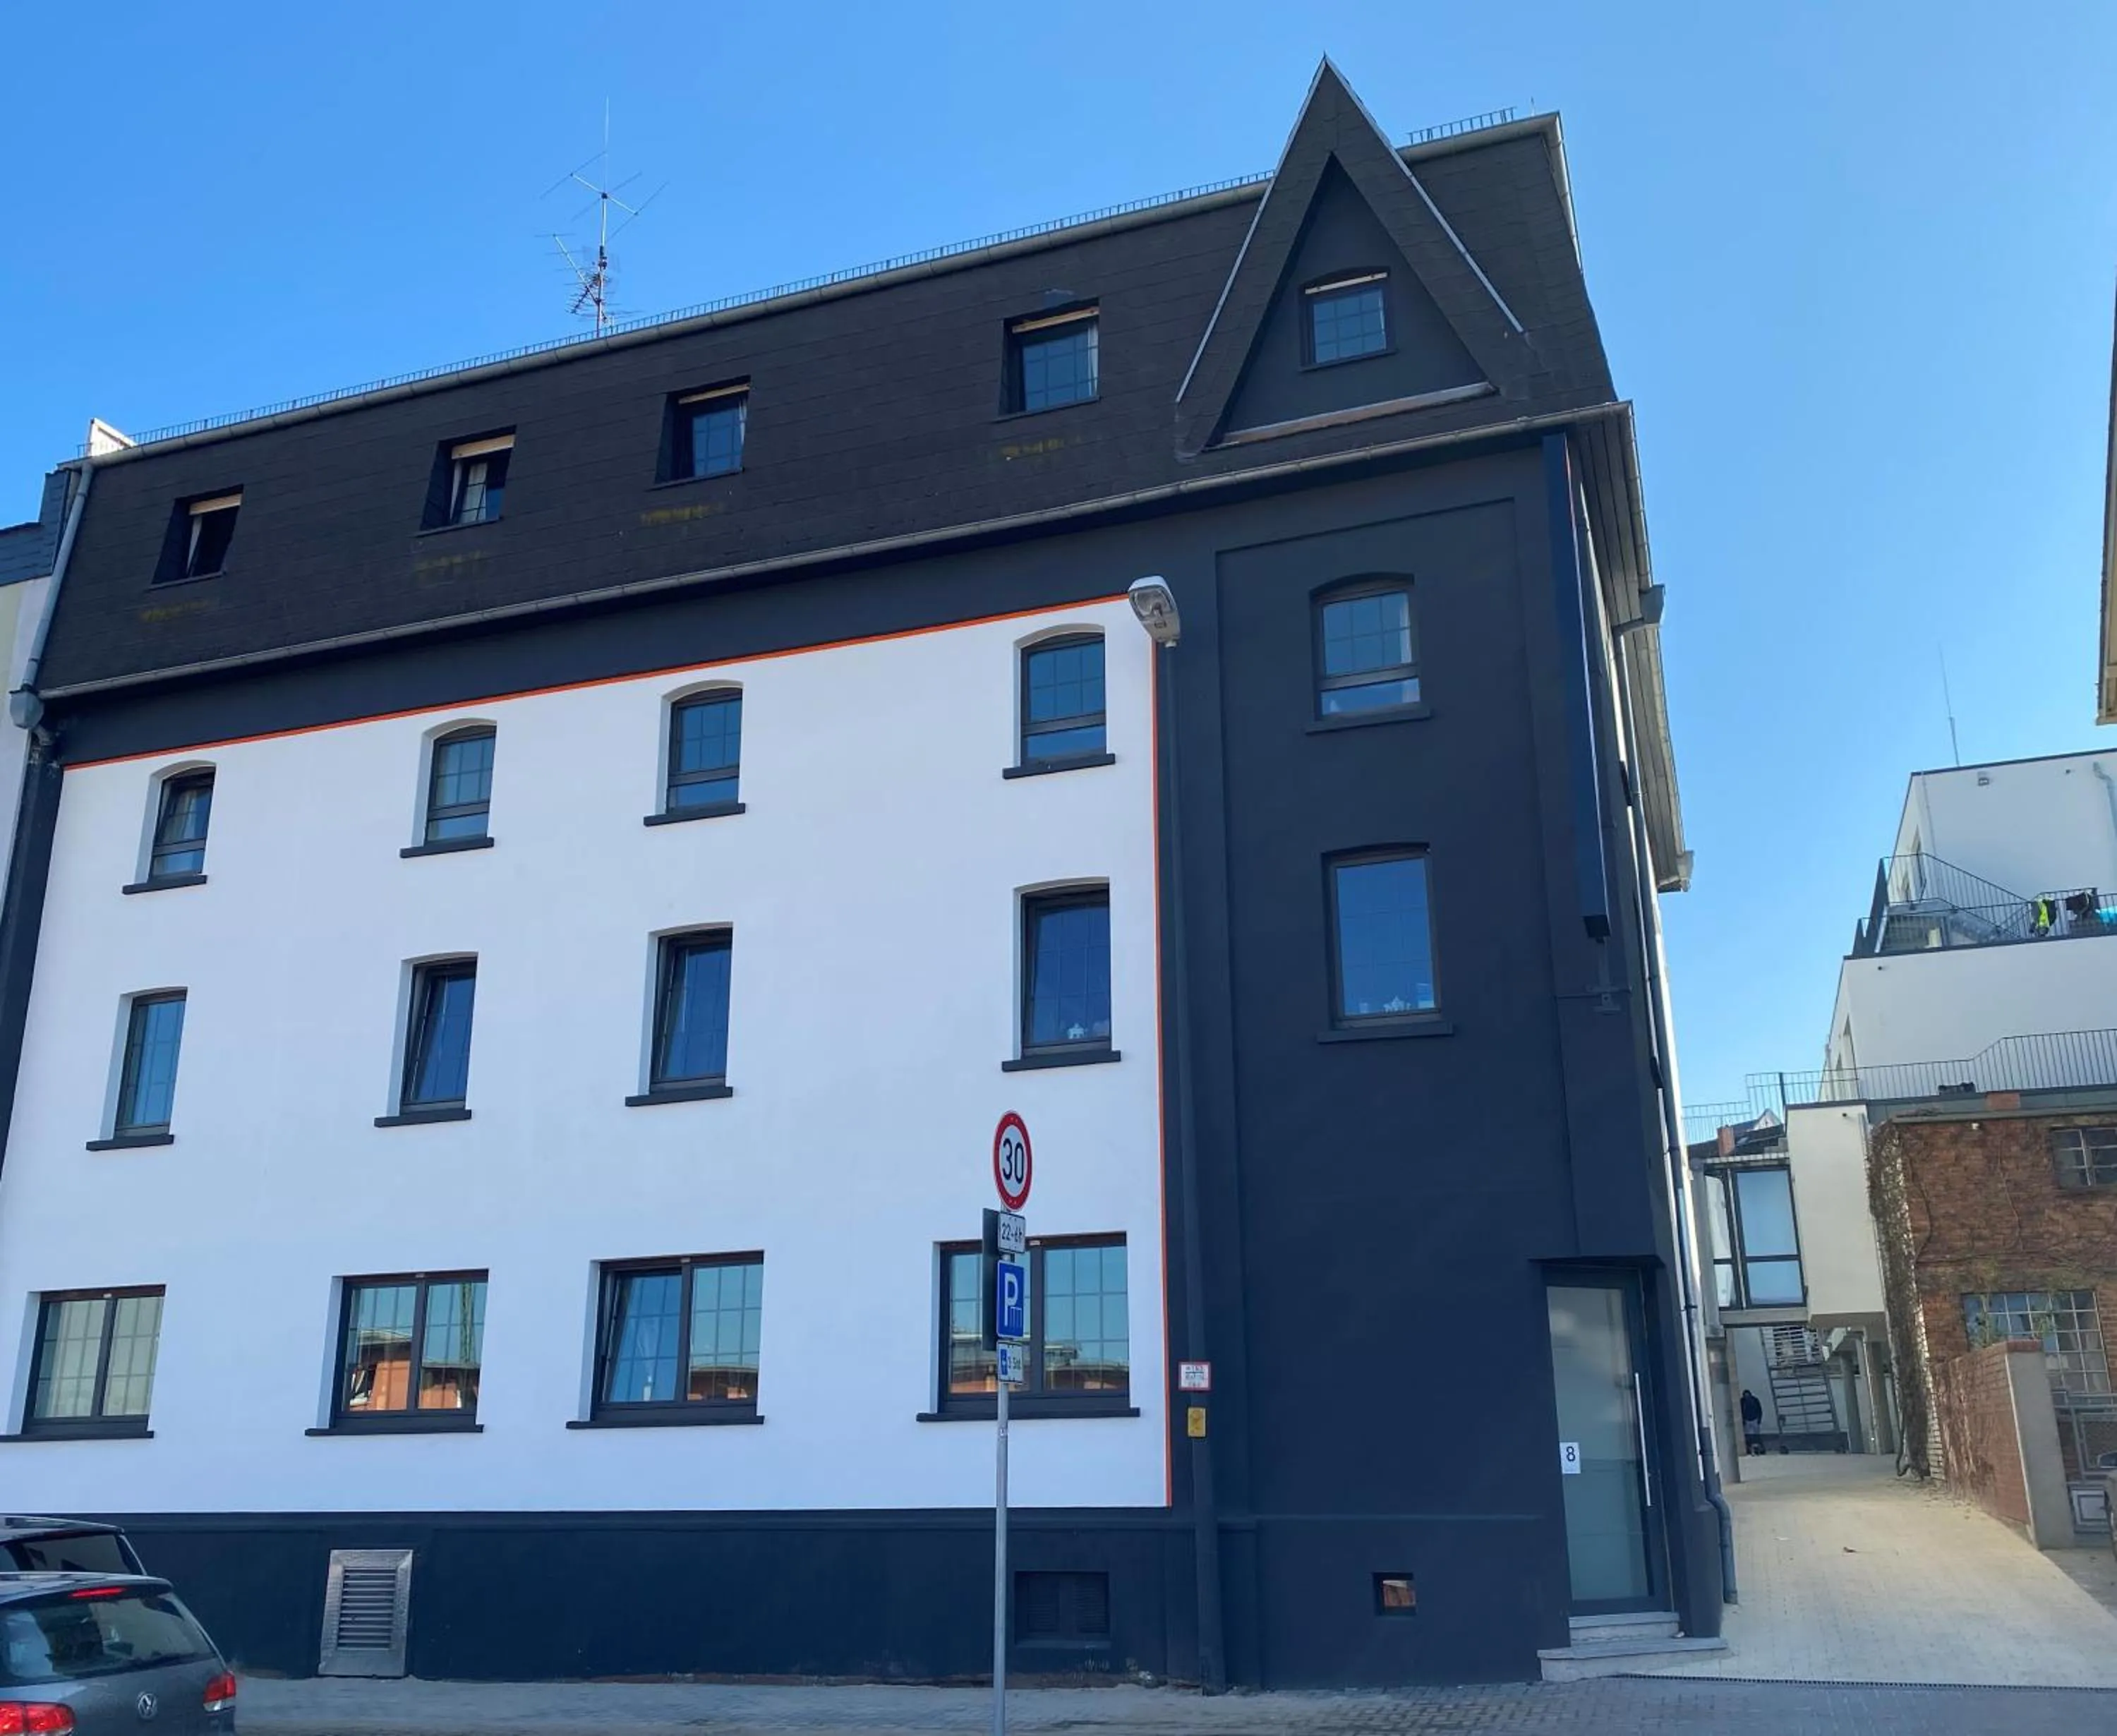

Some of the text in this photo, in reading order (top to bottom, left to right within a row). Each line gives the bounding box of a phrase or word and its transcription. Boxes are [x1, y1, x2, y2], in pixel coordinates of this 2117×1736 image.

[1002, 1137, 1025, 1184] 30
[1004, 1272, 1018, 1327] P
[1566, 1445, 1576, 1462] 8
